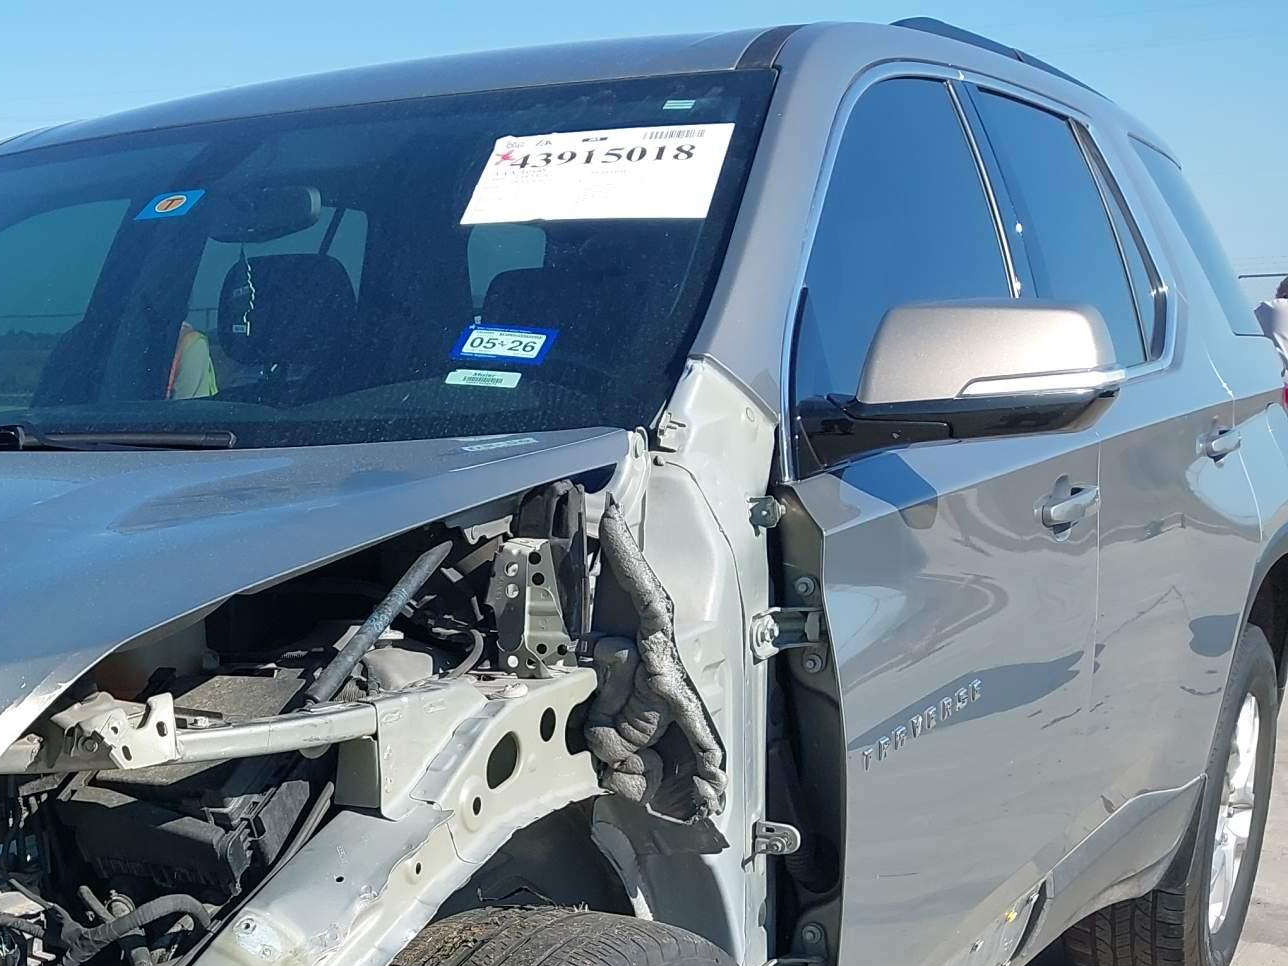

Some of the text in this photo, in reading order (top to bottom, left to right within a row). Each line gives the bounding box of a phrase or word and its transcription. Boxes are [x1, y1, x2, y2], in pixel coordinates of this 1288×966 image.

[510, 144, 696, 169] 43915018
[470, 337, 537, 353] 05 26
[862, 678, 982, 772] TRAVERSE
